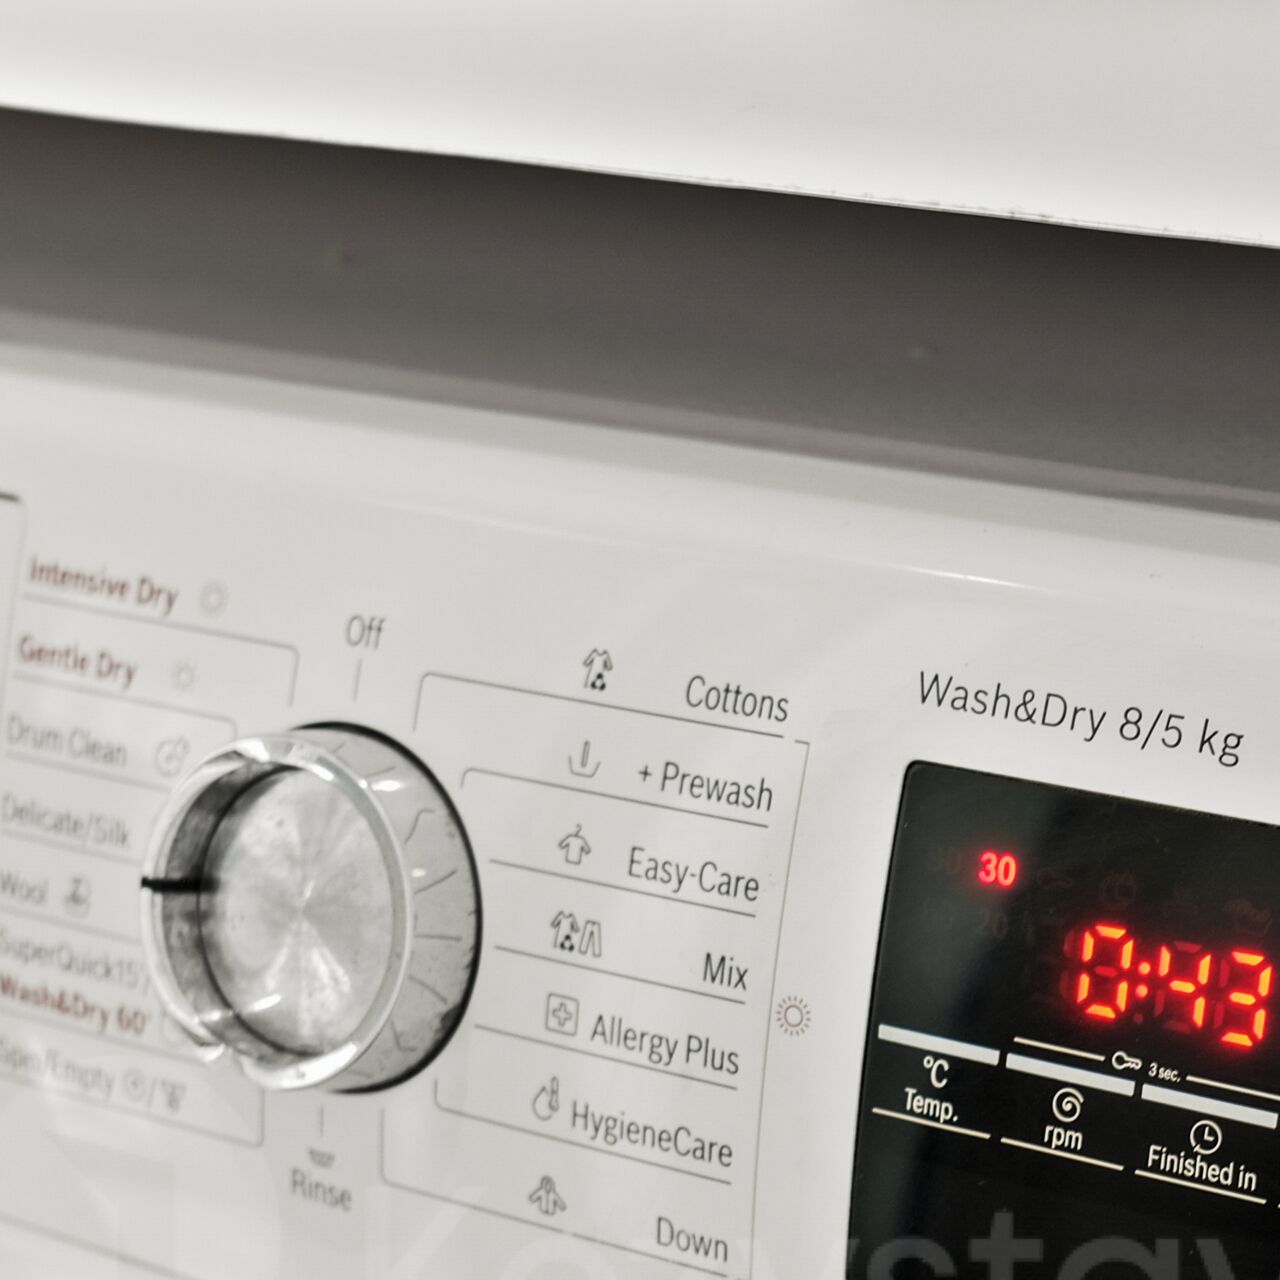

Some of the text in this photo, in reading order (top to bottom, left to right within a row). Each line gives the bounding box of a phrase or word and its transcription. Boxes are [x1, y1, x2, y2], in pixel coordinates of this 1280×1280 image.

[30, 555, 179, 617] Intensive Dry
[345, 614, 386, 650] Off
[16, 634, 138, 692] Gentle Dry
[685, 675, 790, 723] Cottons
[920, 670, 1245, 767] Wash&Dry 8/5 kg
[5, 713, 128, 769] Drum Clean
[660, 761, 774, 812] Prewash
[0, 792, 130, 848] Delicate/Silk
[627, 845, 760, 902] Easy-Care
[977, 850, 1018, 887] 30
[702, 952, 749, 991] Mix
[1075, 921, 1273, 1048] 0:43
[0, 972, 111, 1036] Wash&Dry
[589, 1013, 740, 1076] Allergy Plus
[1148, 1063, 1181, 1083] 3 sec.
[904, 1087, 958, 1123] Temp.
[571, 1100, 734, 1168] HygieneCare
[1044, 1125, 1083, 1150] rpm
[290, 1168, 353, 1212] Rinse
[1148, 1144, 1257, 1192] Finished in
[655, 1215, 729, 1263] Down
